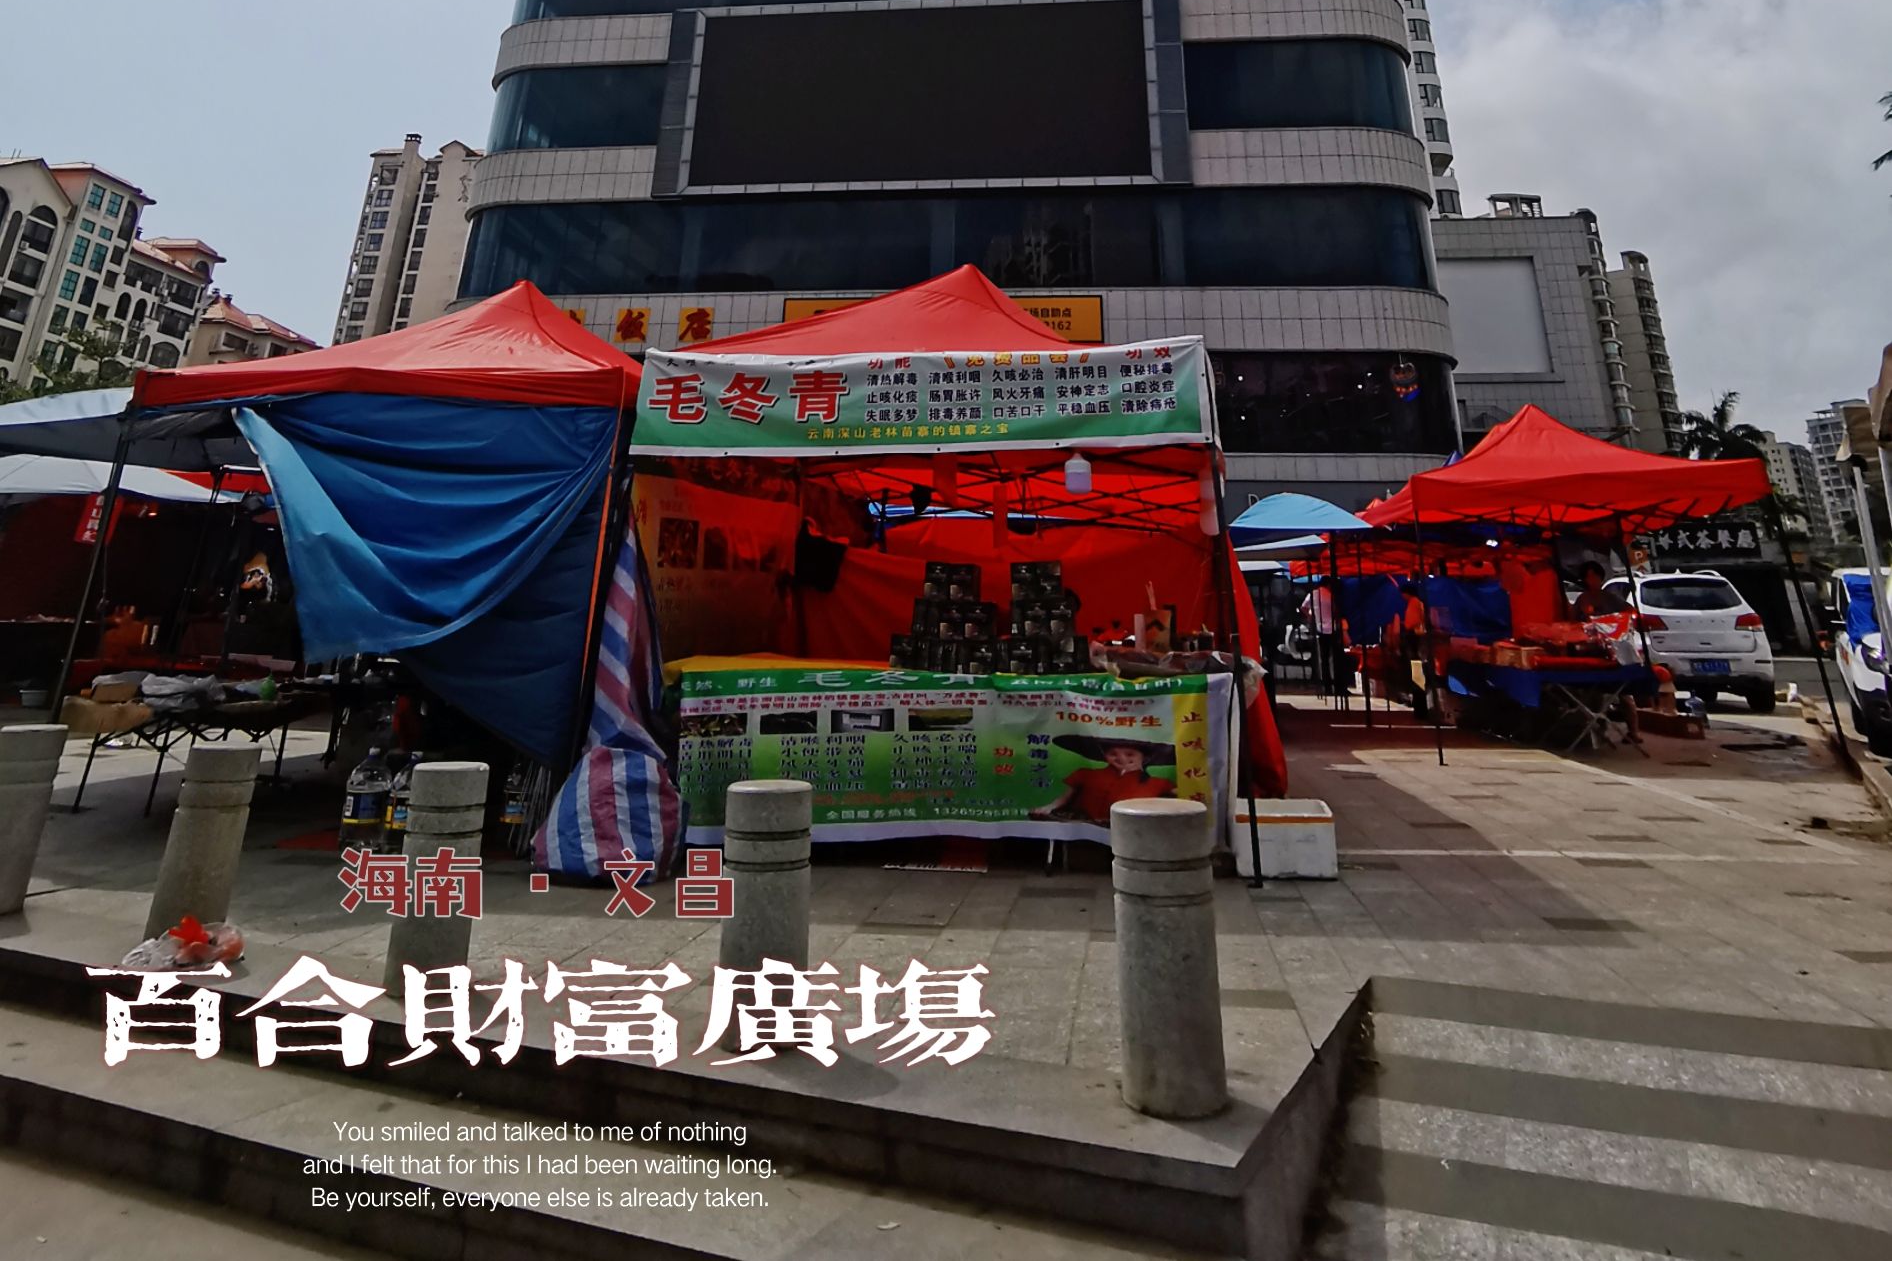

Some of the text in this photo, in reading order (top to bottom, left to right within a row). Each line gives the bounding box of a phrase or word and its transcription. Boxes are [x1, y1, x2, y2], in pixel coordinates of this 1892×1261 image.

[867, 372, 917, 386] 清热解毒
[992, 367, 1045, 383] 久咳必治
[1054, 365, 1108, 380] 清肝明目
[1120, 362, 1173, 378] 便秘排毒
[648, 369, 851, 425] 毛冬青
[866, 390, 918, 404] 止咳化痰
[992, 386, 1046, 401] 风火牙痛
[1056, 383, 1110, 399] 安神定志
[1121, 380, 1175, 395] 口腔炎症
[866, 408, 918, 422] 失眠多梦
[928, 406, 981, 421] 排毒养颜
[993, 404, 1046, 419] 口苦口干
[1057, 400, 1111, 416] 平稳血压
[1055, 711, 1163, 728] 100%野生
